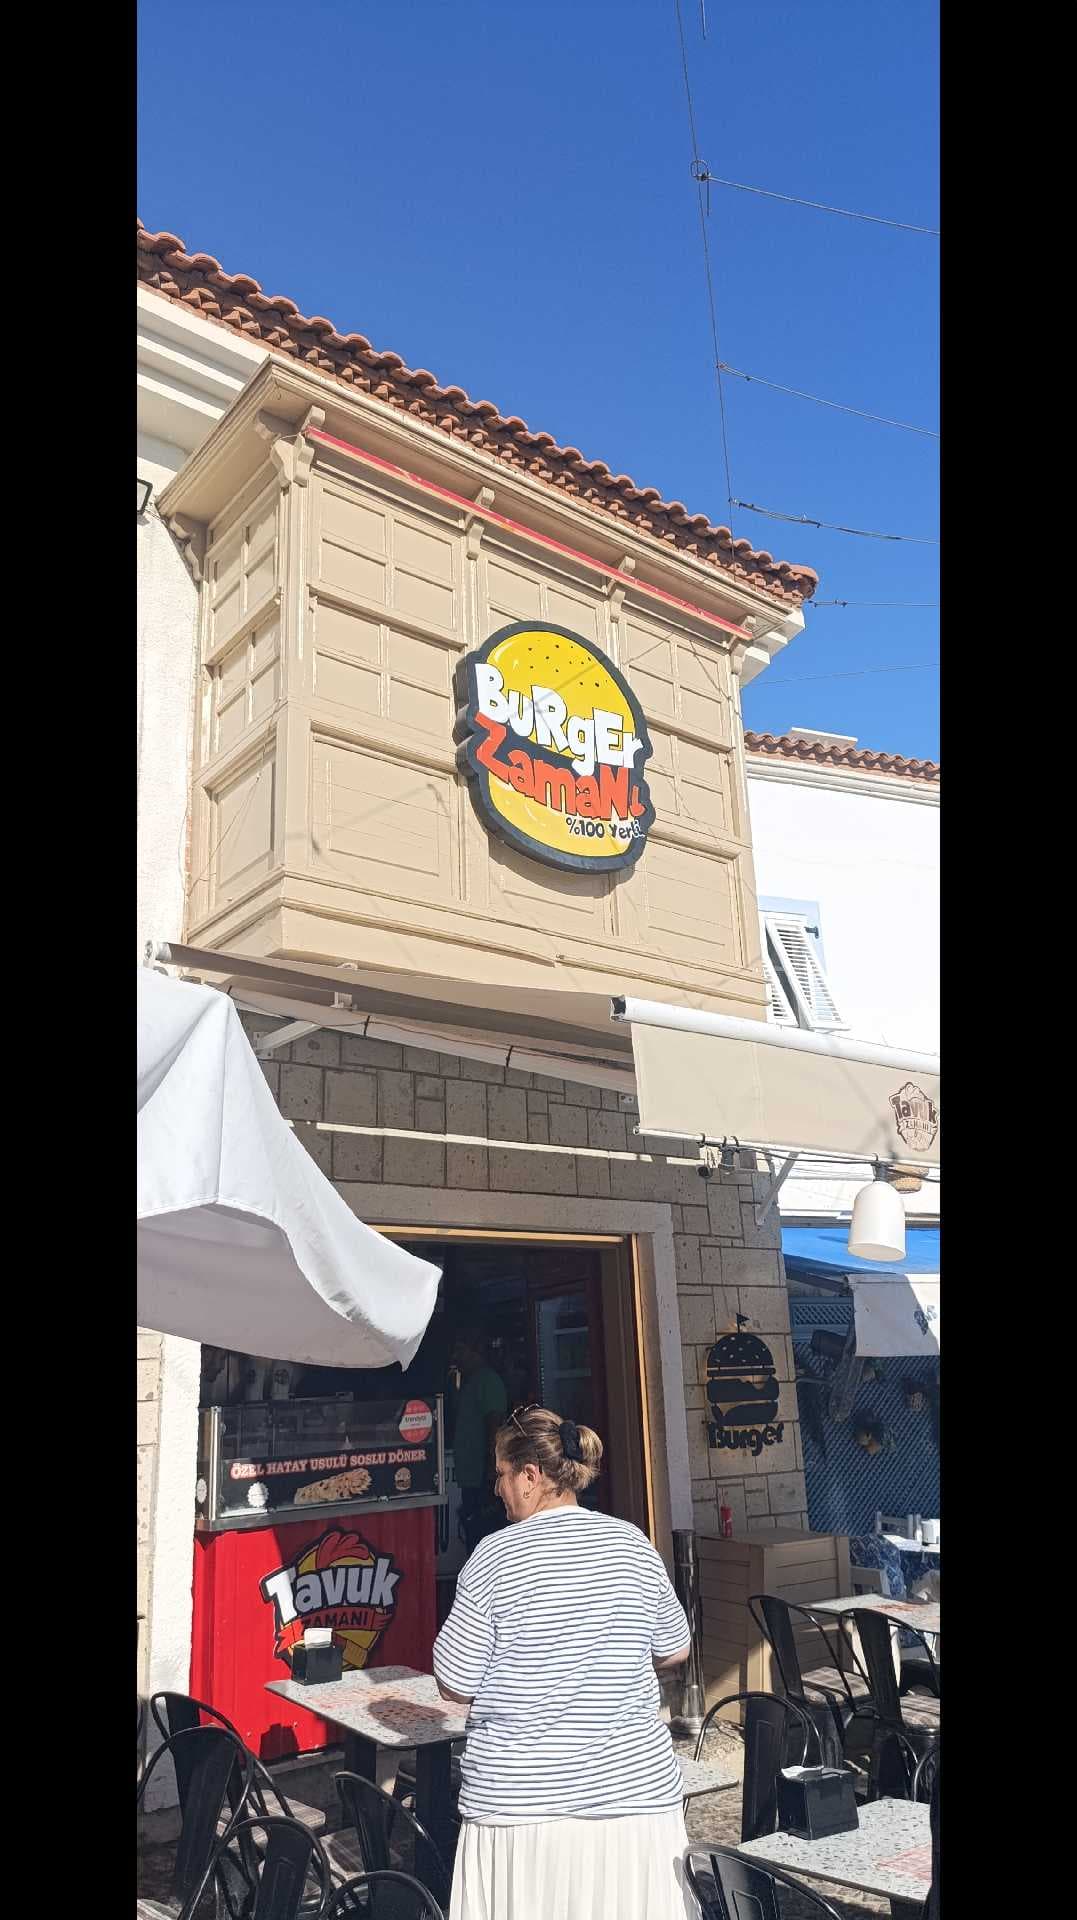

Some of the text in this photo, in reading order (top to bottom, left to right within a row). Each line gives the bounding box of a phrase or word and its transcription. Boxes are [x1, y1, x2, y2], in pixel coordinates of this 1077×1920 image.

[566, 817, 605, 839] %100
[230, 1449, 427, 1479] ÖZEL HATAY USULÜ SOSLU DÖNER
[263, 1558, 401, 1625] Tavuk
